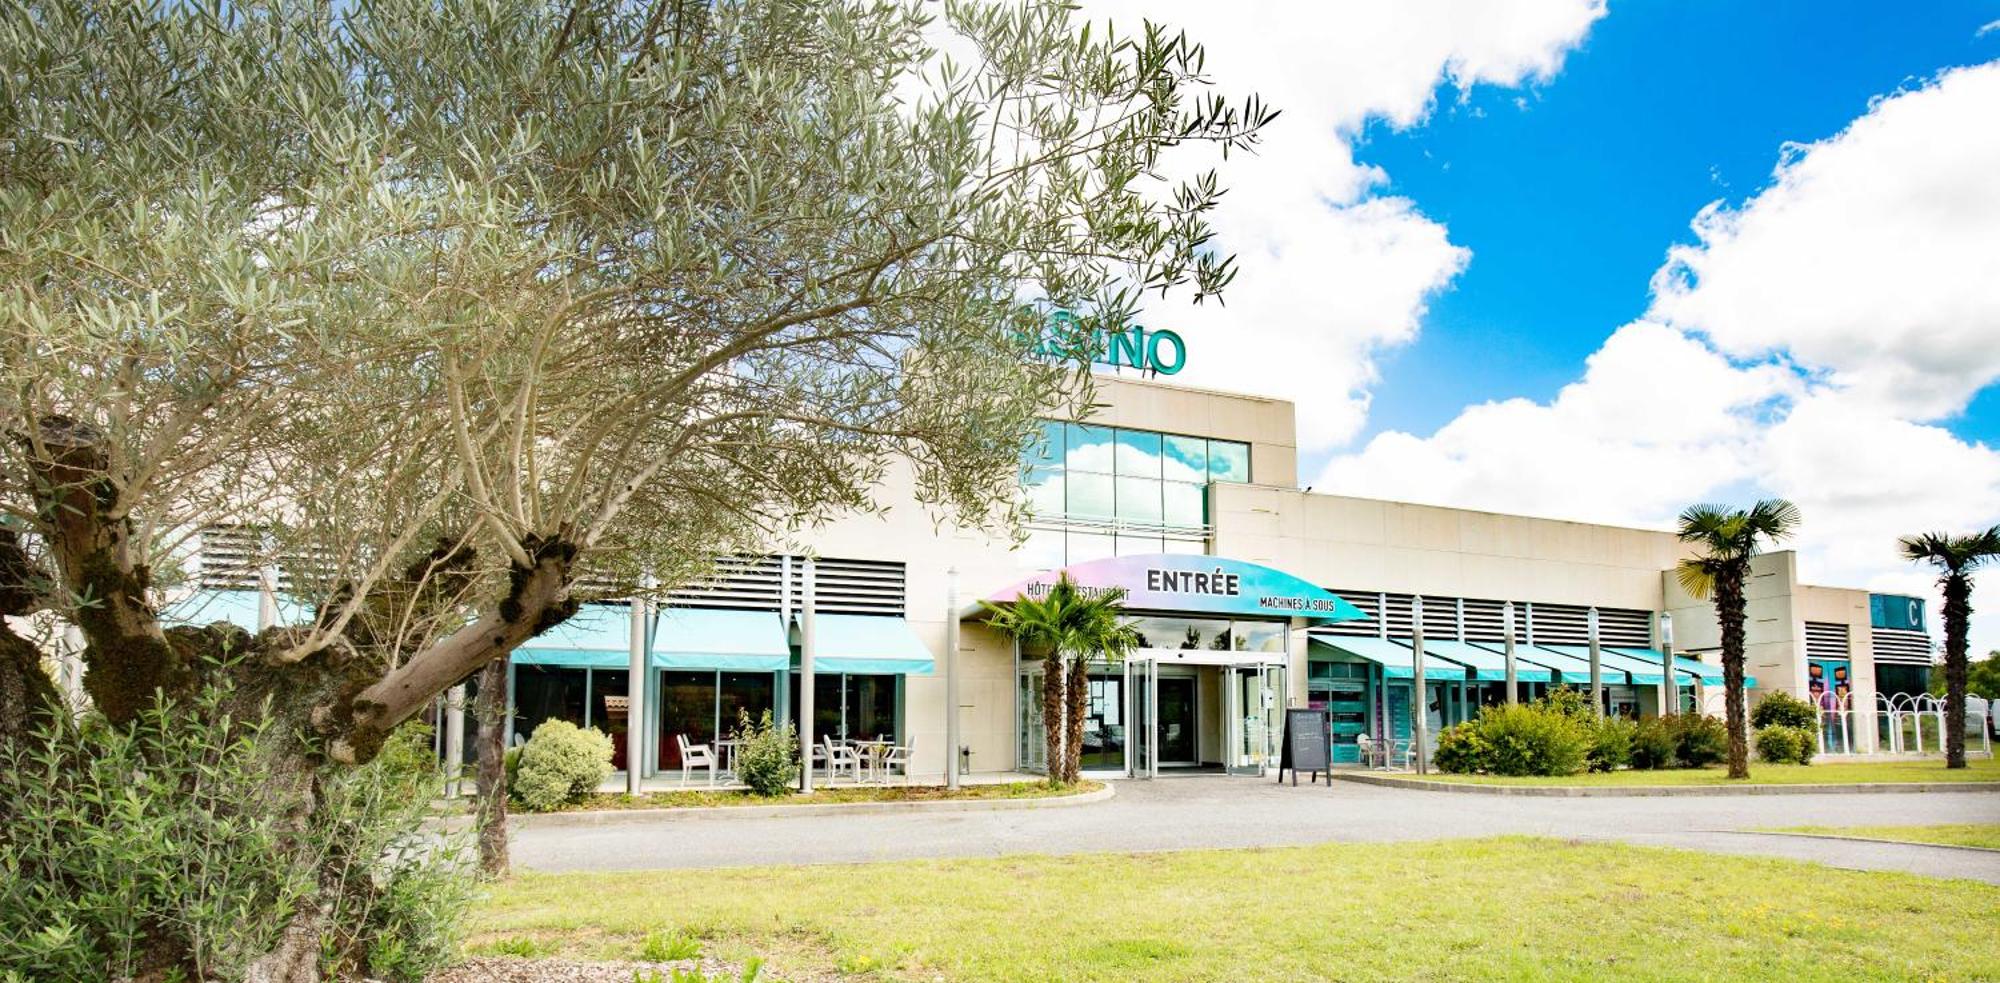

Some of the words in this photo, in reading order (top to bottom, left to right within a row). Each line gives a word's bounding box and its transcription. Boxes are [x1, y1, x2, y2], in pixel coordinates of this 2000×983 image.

[1027, 581, 1060, 597] HÔTE
[1073, 585, 1131, 601] ESTAURNT
[1147, 567, 1240, 596] ENTRÉE
[1260, 597, 1303, 610] MACHINES
[1305, 595, 1311, 610] À
[1312, 600, 1334, 612] SOUS
